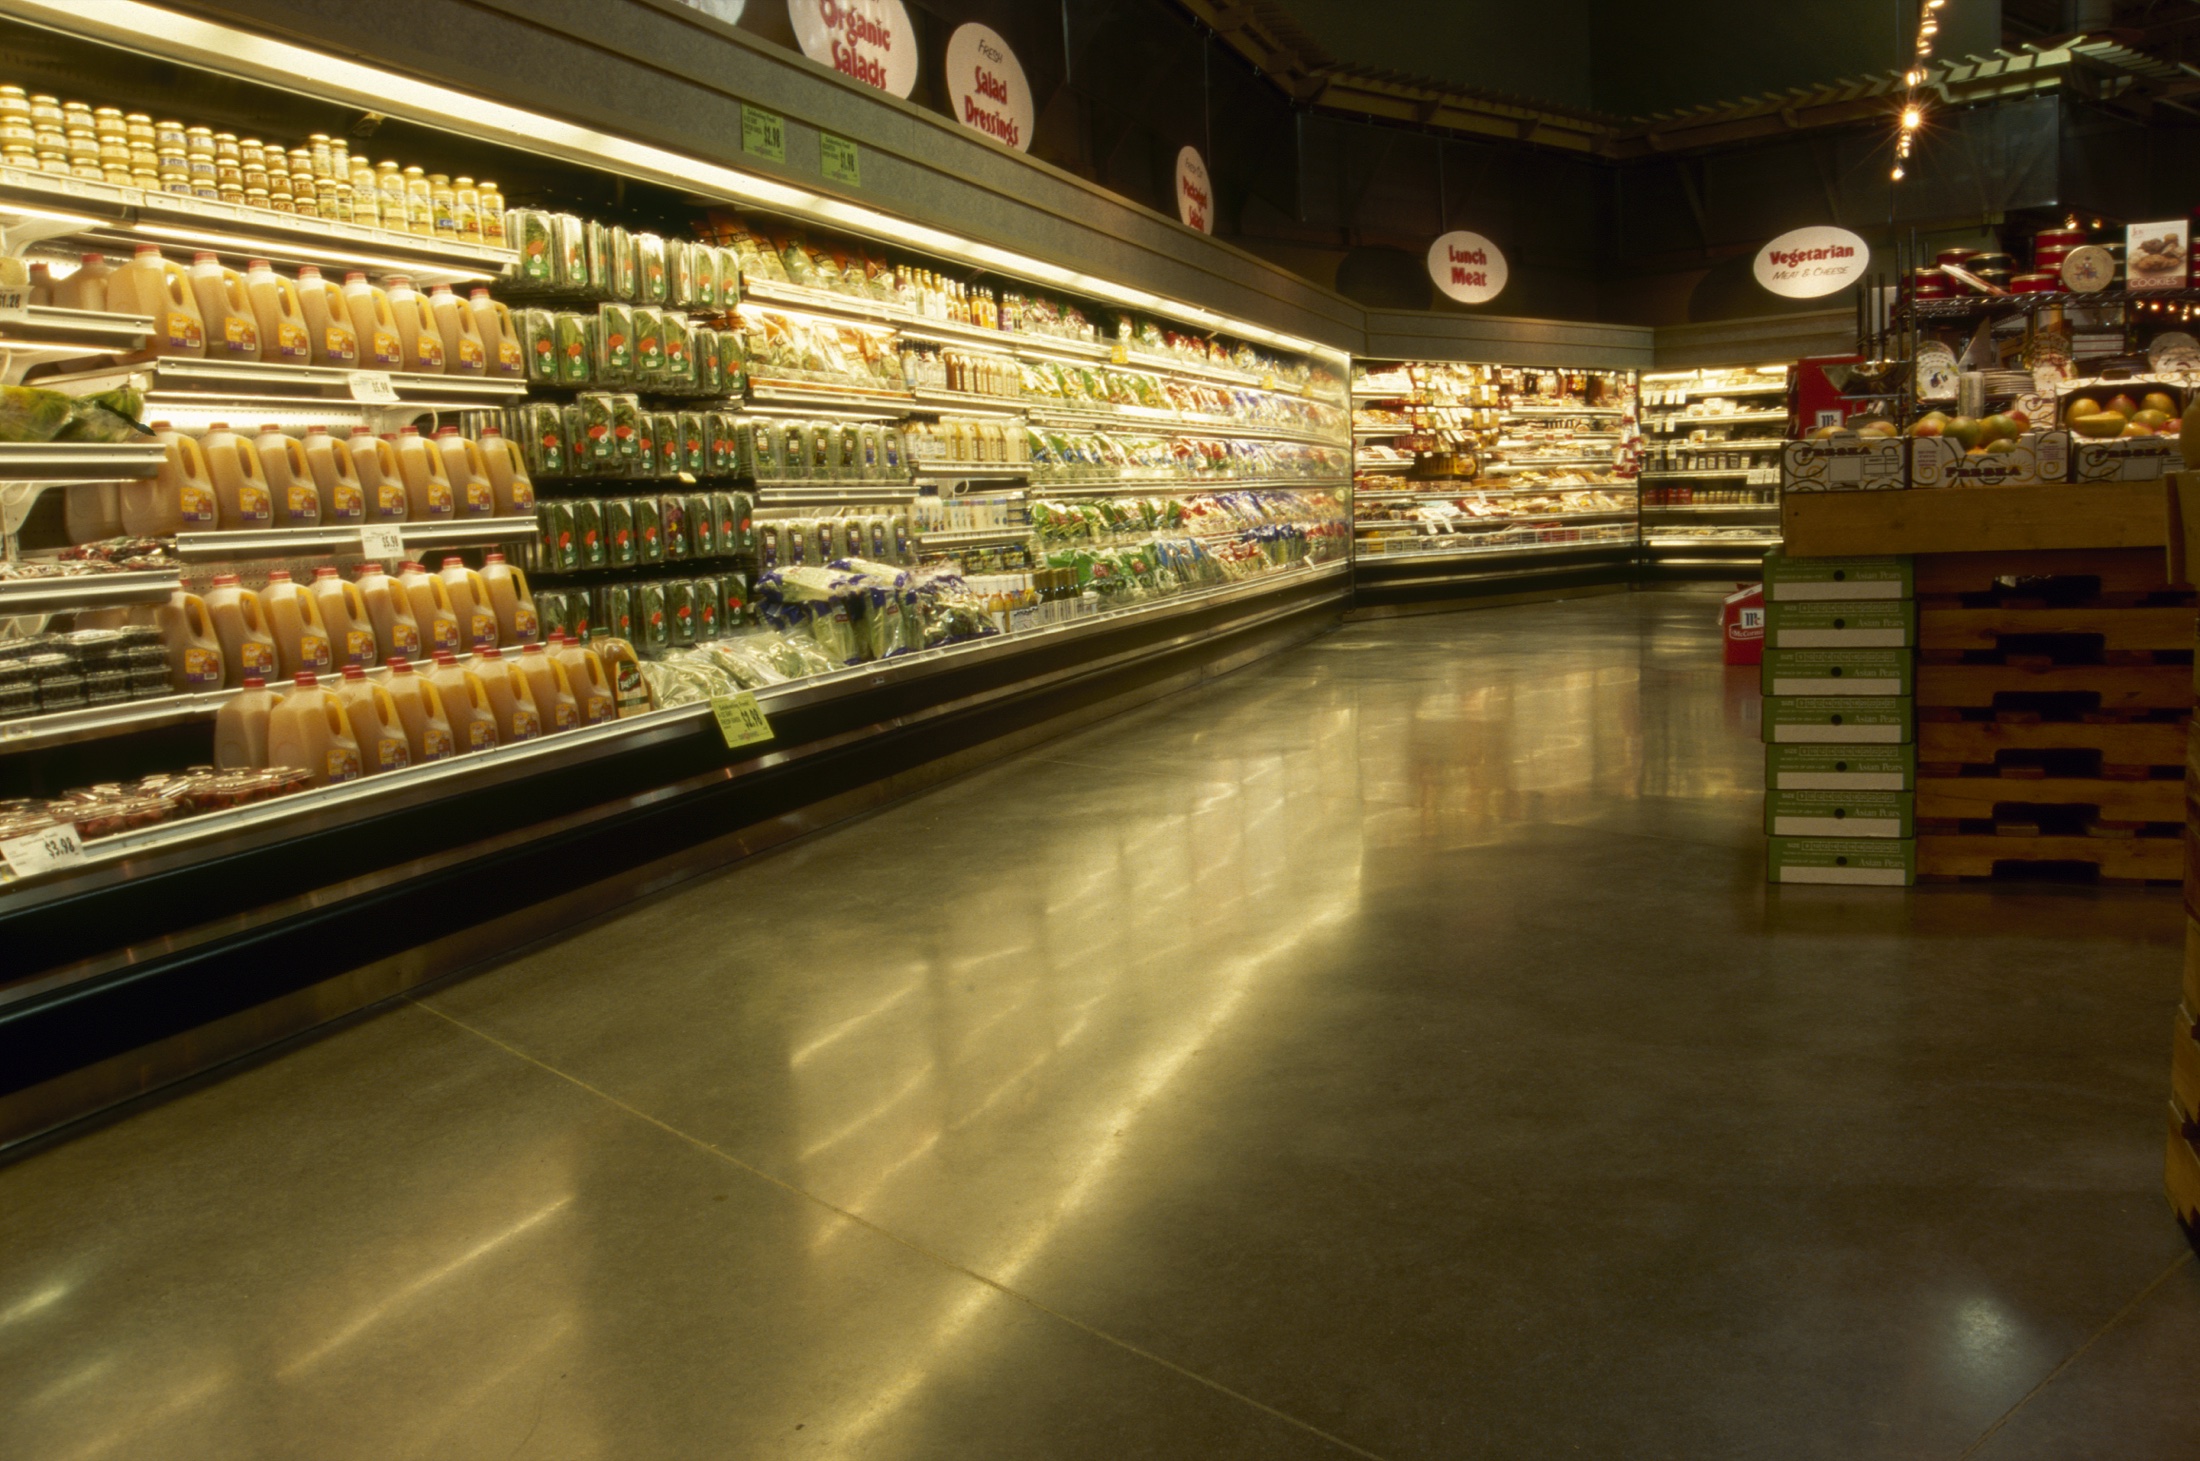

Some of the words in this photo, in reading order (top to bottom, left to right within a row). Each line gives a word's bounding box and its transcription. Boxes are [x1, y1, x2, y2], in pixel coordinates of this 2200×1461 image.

[819, 0, 890, 51] Organic
[831, 40, 887, 90] Salads
[975, 66, 1007, 105] Salad
[964, 95, 1019, 147] Dressings
[1448, 244, 1487, 265] Lunch
[1769, 244, 1855, 268] Vegetarian
[1451, 267, 1487, 287] Meat
[2129, 277, 2178, 288] COOKIES
[1882, 618, 1904, 626] Pears
[44, 836, 76, 860] $3.98
[1859, 858, 1881, 866] Asian
[1884, 858, 1905, 866] Pears
